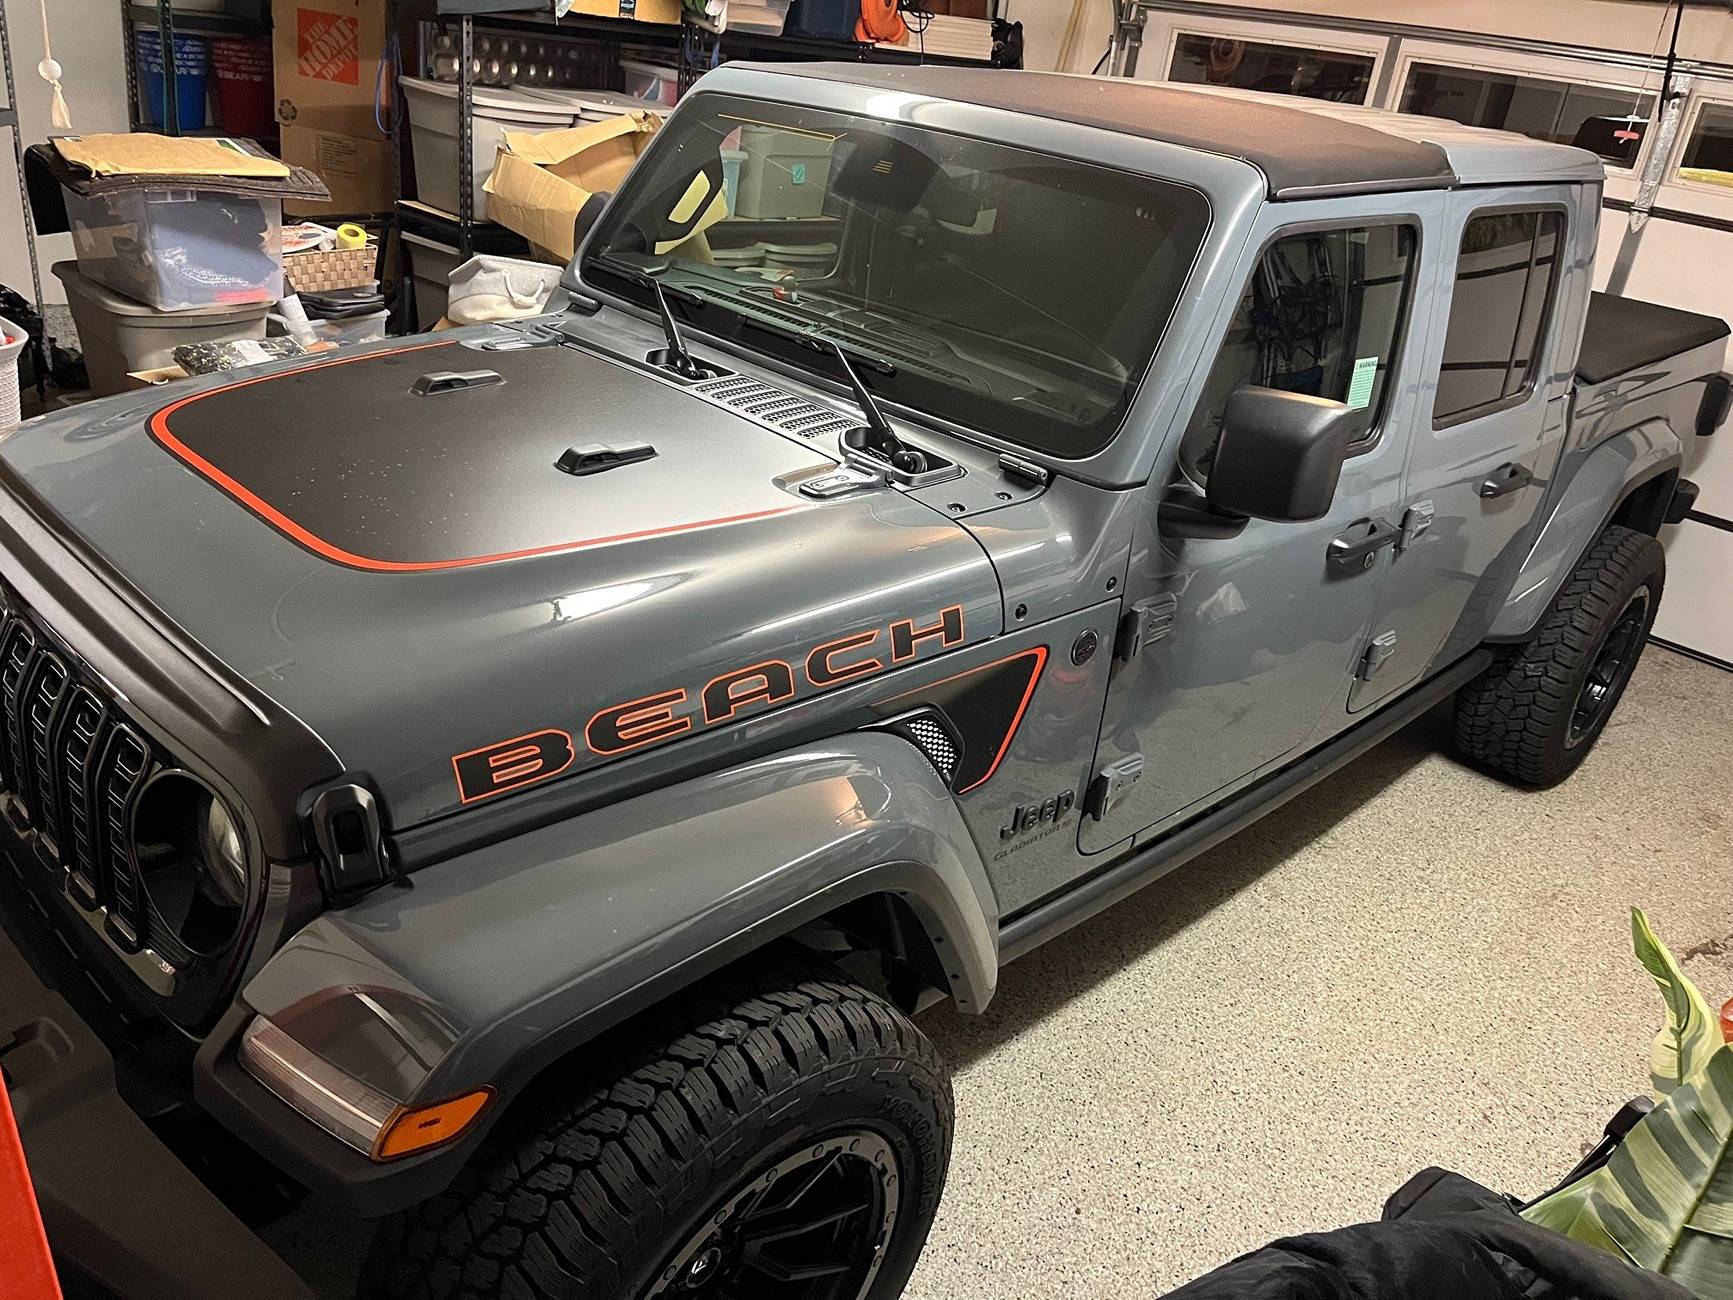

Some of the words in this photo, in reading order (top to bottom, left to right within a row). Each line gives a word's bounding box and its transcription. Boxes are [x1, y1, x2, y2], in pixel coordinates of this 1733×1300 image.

[299, 15, 358, 77] HOME
[303, 20, 326, 44] THE
[321, 45, 358, 81] DEPOT
[451, 604, 965, 804] BEACH
[999, 788, 1075, 841] Jeep
[993, 823, 1061, 861] GLADIATOR
